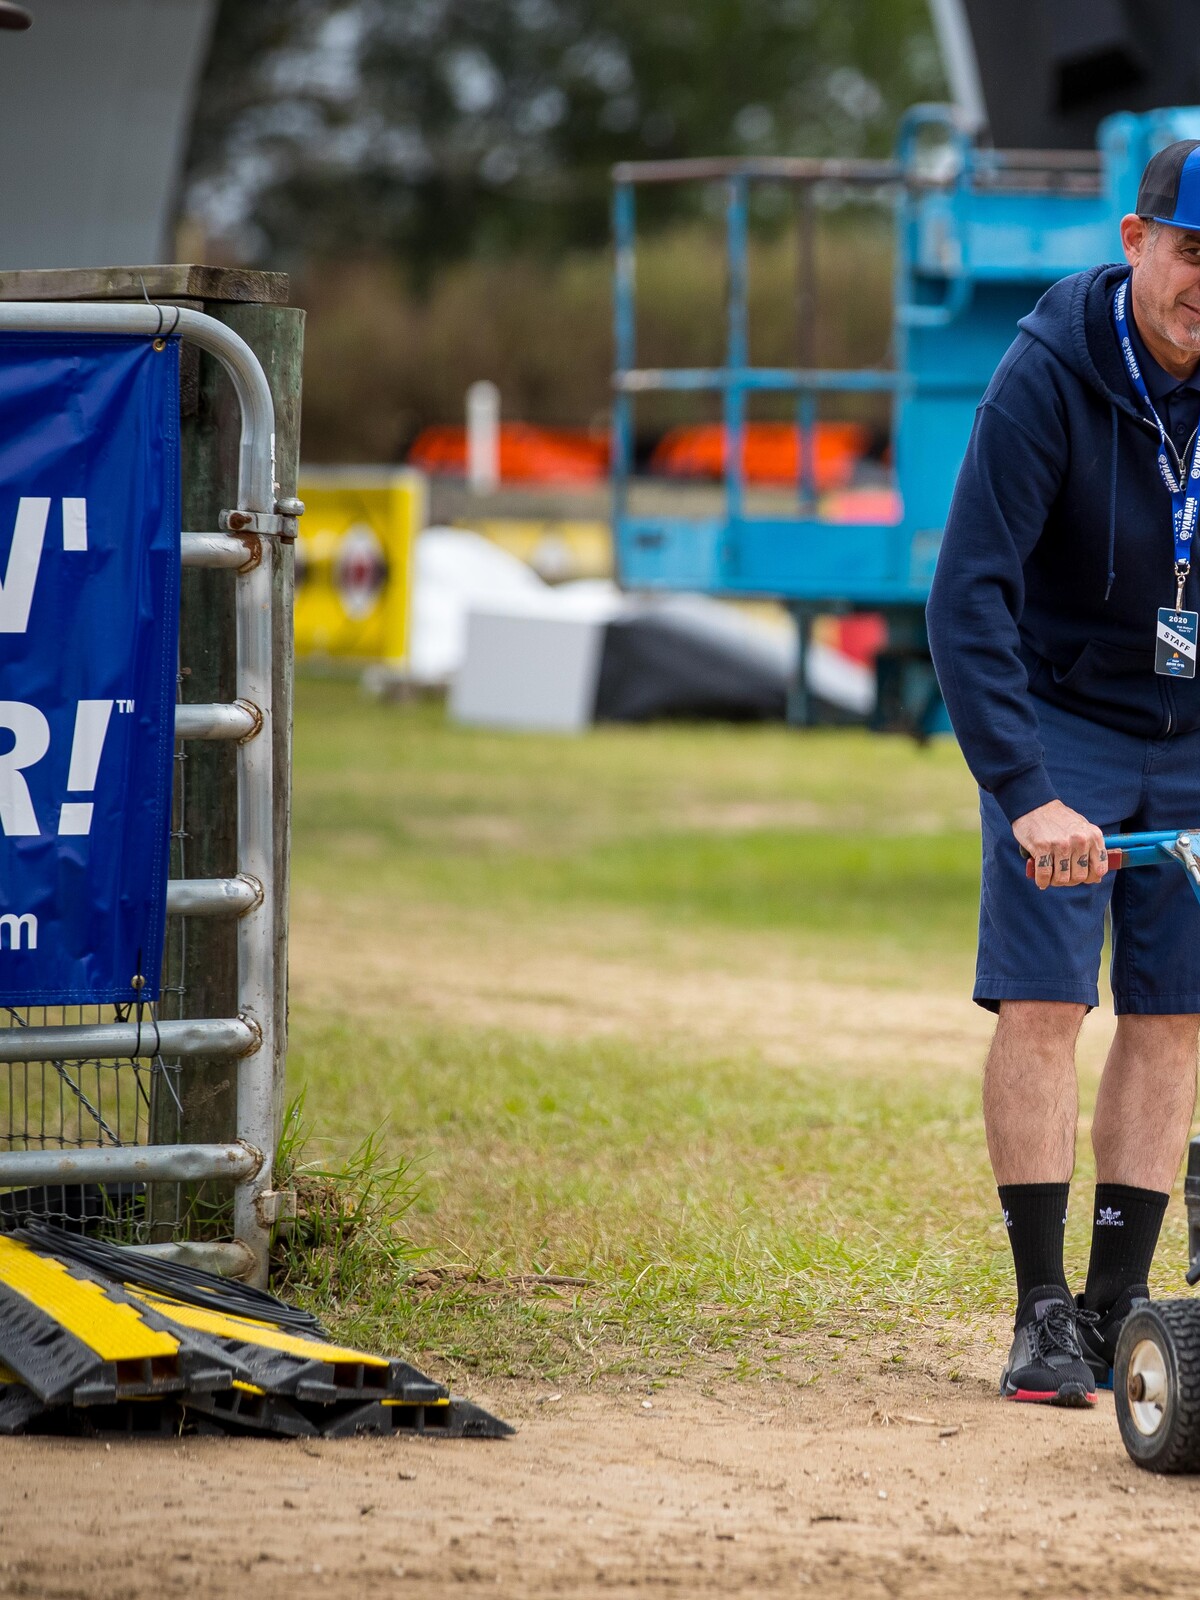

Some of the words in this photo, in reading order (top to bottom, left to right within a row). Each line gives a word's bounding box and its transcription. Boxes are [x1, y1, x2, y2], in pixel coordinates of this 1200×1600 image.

[1118, 288, 1126, 321] YAMAHA
[1125, 346, 1140, 380] YAMAHA
[1162, 463, 1180, 494] YAMAHA
[1182, 497, 1195, 530] YAMAHA
[1168, 616, 1188, 624] 2020
[1164, 631, 1190, 650] STAFF
